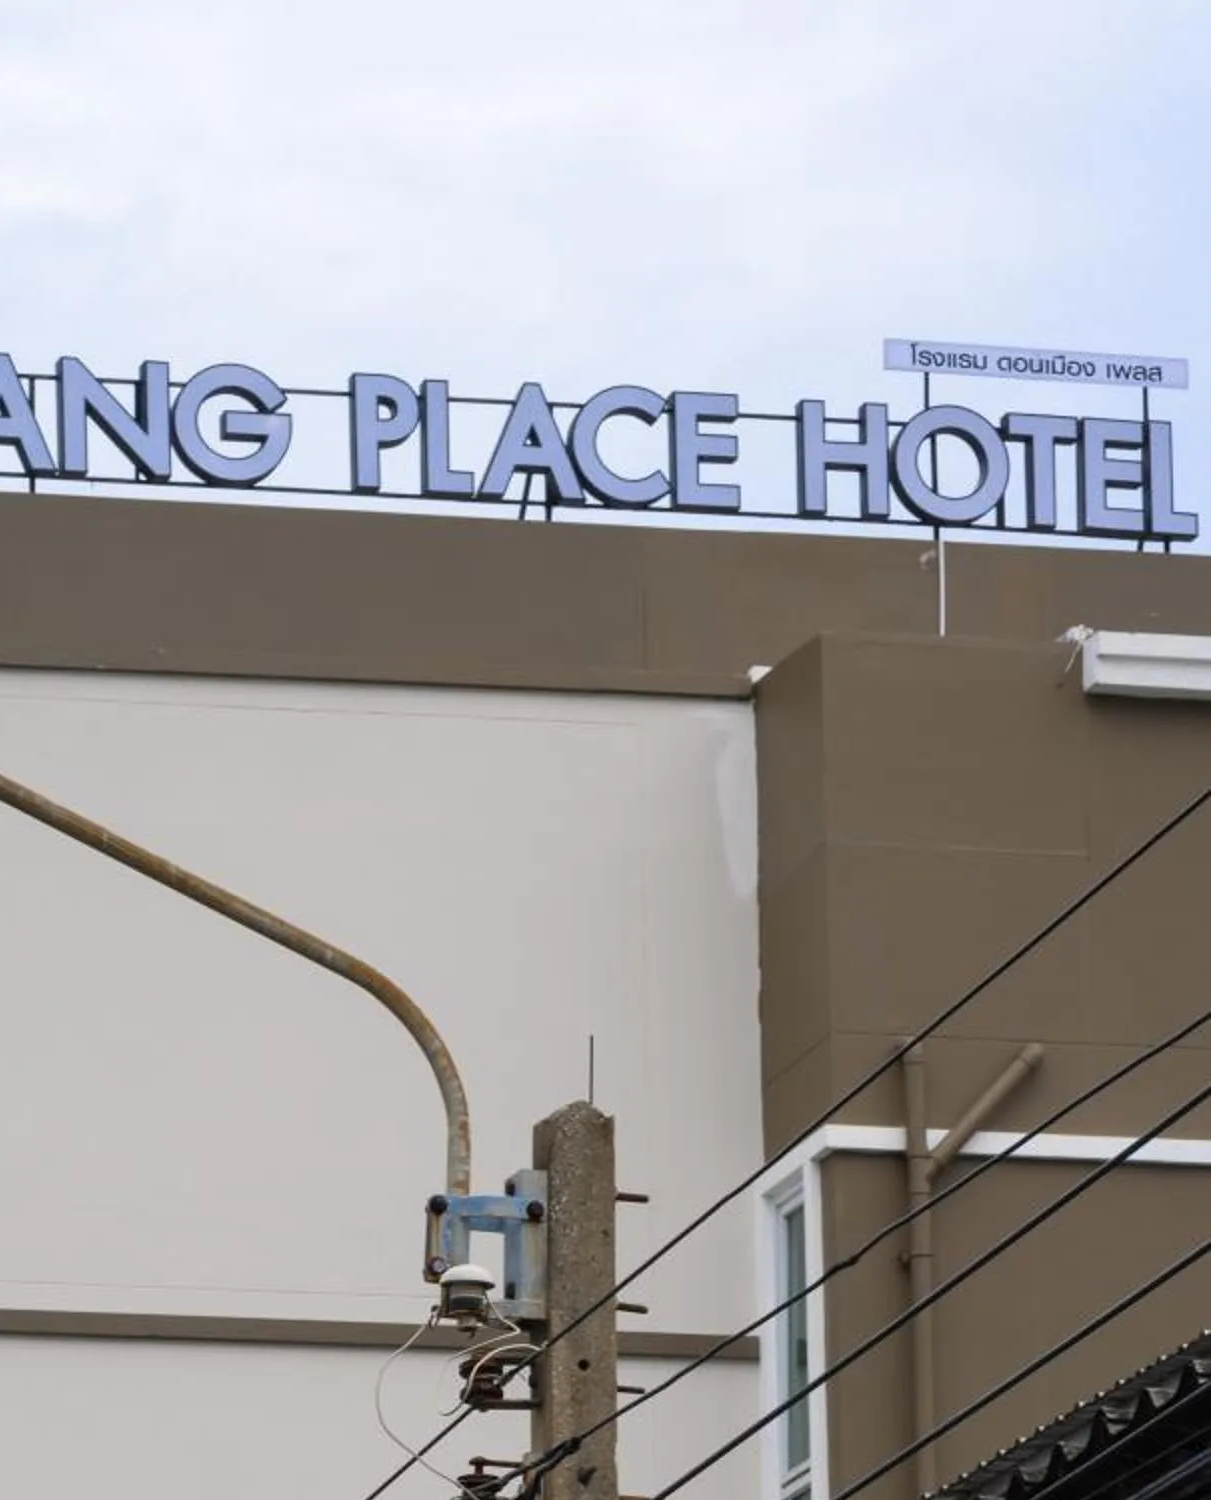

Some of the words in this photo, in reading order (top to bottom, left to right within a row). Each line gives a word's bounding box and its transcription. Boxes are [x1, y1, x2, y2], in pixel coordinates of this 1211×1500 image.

[910, 342, 988, 371] โรงแรม
[351, 372, 741, 512] PLACE
[796, 399, 1199, 542] HOTEL
